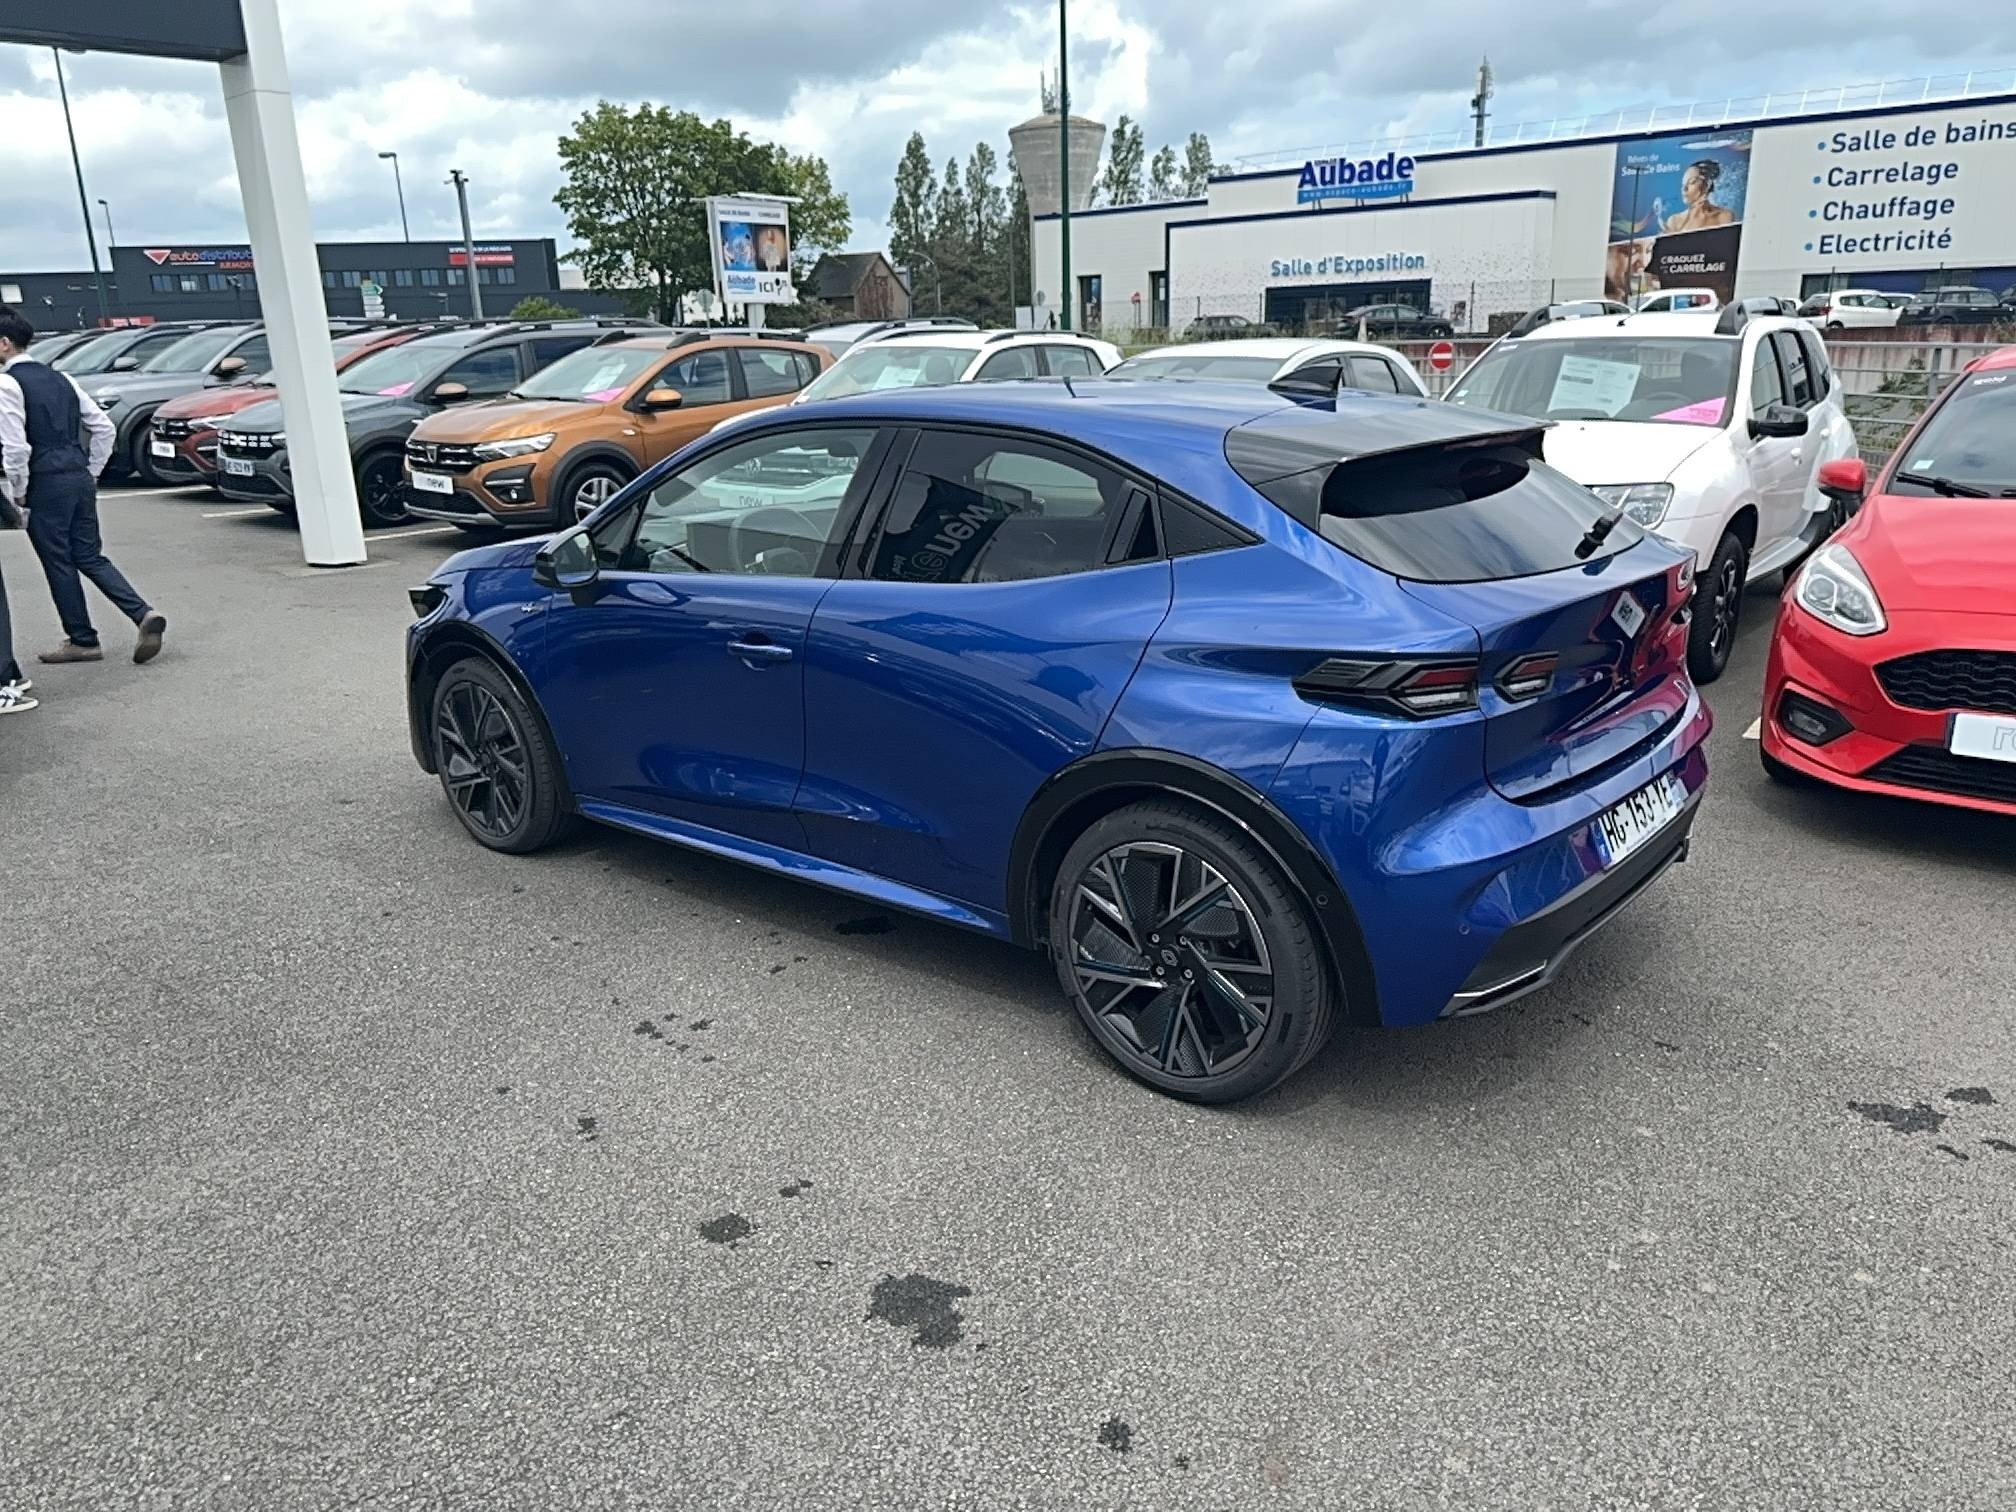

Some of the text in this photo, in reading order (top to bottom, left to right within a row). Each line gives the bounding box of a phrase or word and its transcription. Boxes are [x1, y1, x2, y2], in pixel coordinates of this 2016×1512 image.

[1831, 119, 2016, 153] Salle de bains
[1298, 152, 1414, 188] Aubade
[1827, 162, 1959, 186] Carrelage
[1823, 196, 1955, 221] Chauffage
[1818, 227, 1952, 255] Electricité
[1271, 251, 1425, 277] Salle d'Exposition
[1669, 261, 1726, 273] CARRELAGE
